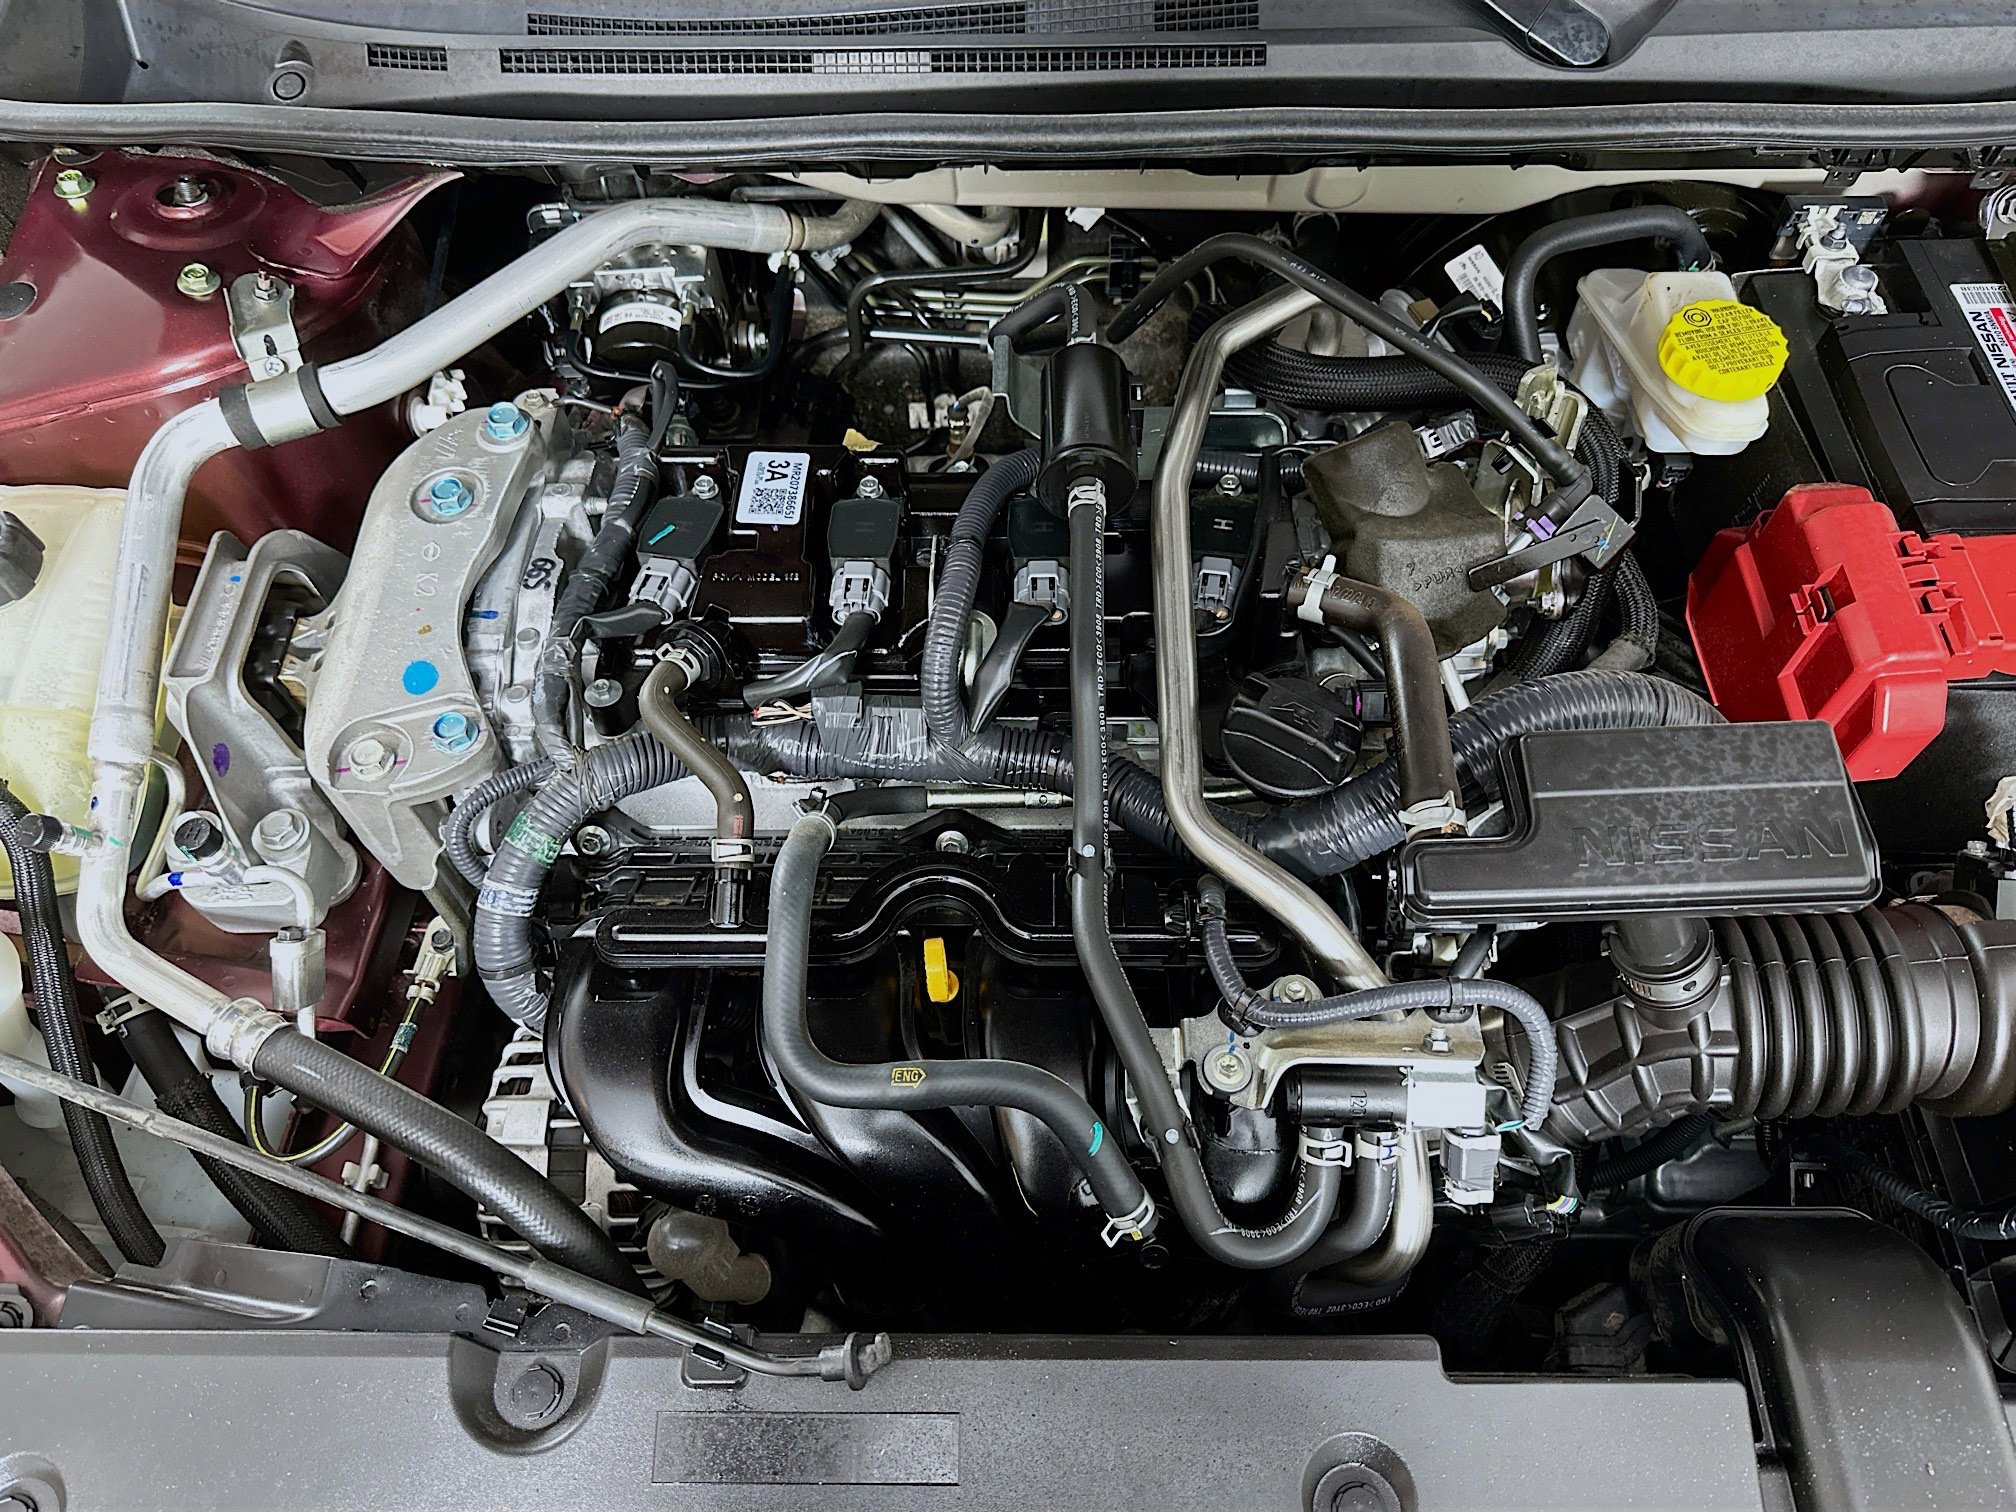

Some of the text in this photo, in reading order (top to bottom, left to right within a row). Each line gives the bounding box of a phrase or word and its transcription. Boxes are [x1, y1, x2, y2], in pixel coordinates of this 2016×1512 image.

[1968, 311, 2010, 369] NISSAN
[765, 460, 791, 483] 3A
[784, 462, 802, 519] MR20738665J
[1094, 538, 1105, 608] TRD>ECO<3908
[1095, 613, 1106, 698] TRD>ECO<3908
[1098, 705, 1107, 793] TRD>ECO<3908
[1572, 818, 1849, 868] NISSAN
[895, 1070, 919, 1082] ENG
[1350, 1090, 1368, 1117] 120
